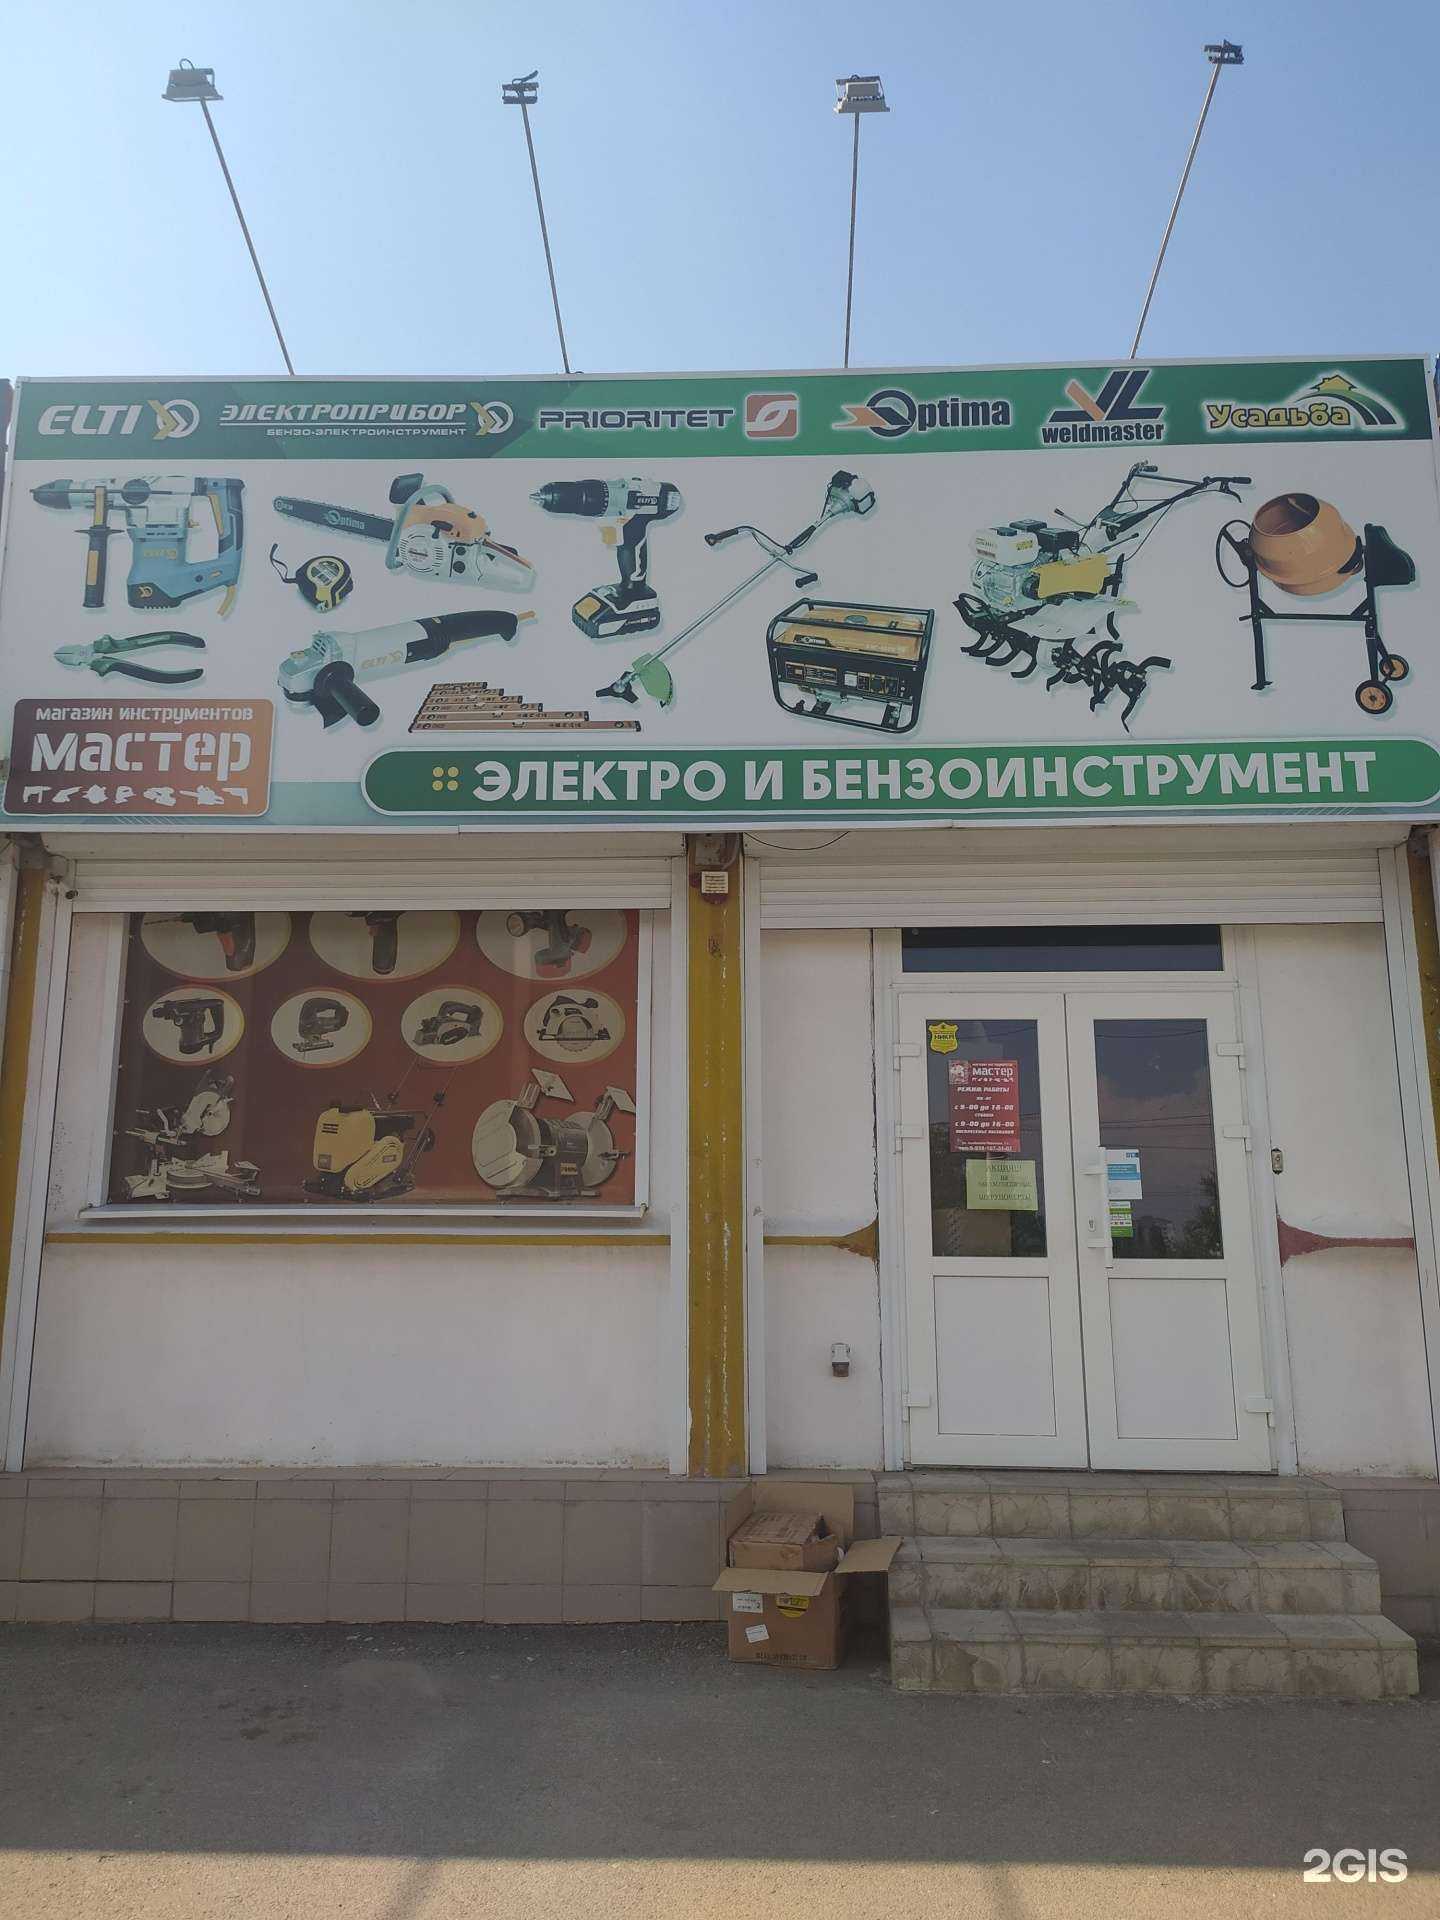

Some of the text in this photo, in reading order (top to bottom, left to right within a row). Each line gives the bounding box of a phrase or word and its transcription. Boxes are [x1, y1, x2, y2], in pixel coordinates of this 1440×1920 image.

[38, 404, 143, 436] ELTI
[219, 402, 467, 422] ЭЛЕКТРОПРИБОР
[538, 408, 735, 430] PRIORITET
[864, 389, 1012, 438] Optima
[1205, 402, 1352, 429] Усадьба
[266, 427, 467, 437] БЕНЗО-ЭЛЕКТРОИНСТРУМЕНТ
[1041, 421, 1165, 444] weldmaster
[35, 707, 254, 725] магазин инструментов
[472, 751, 1377, 802] ЭЛЕКТРО И БЕНЗОИНСТРУМЕНТ
